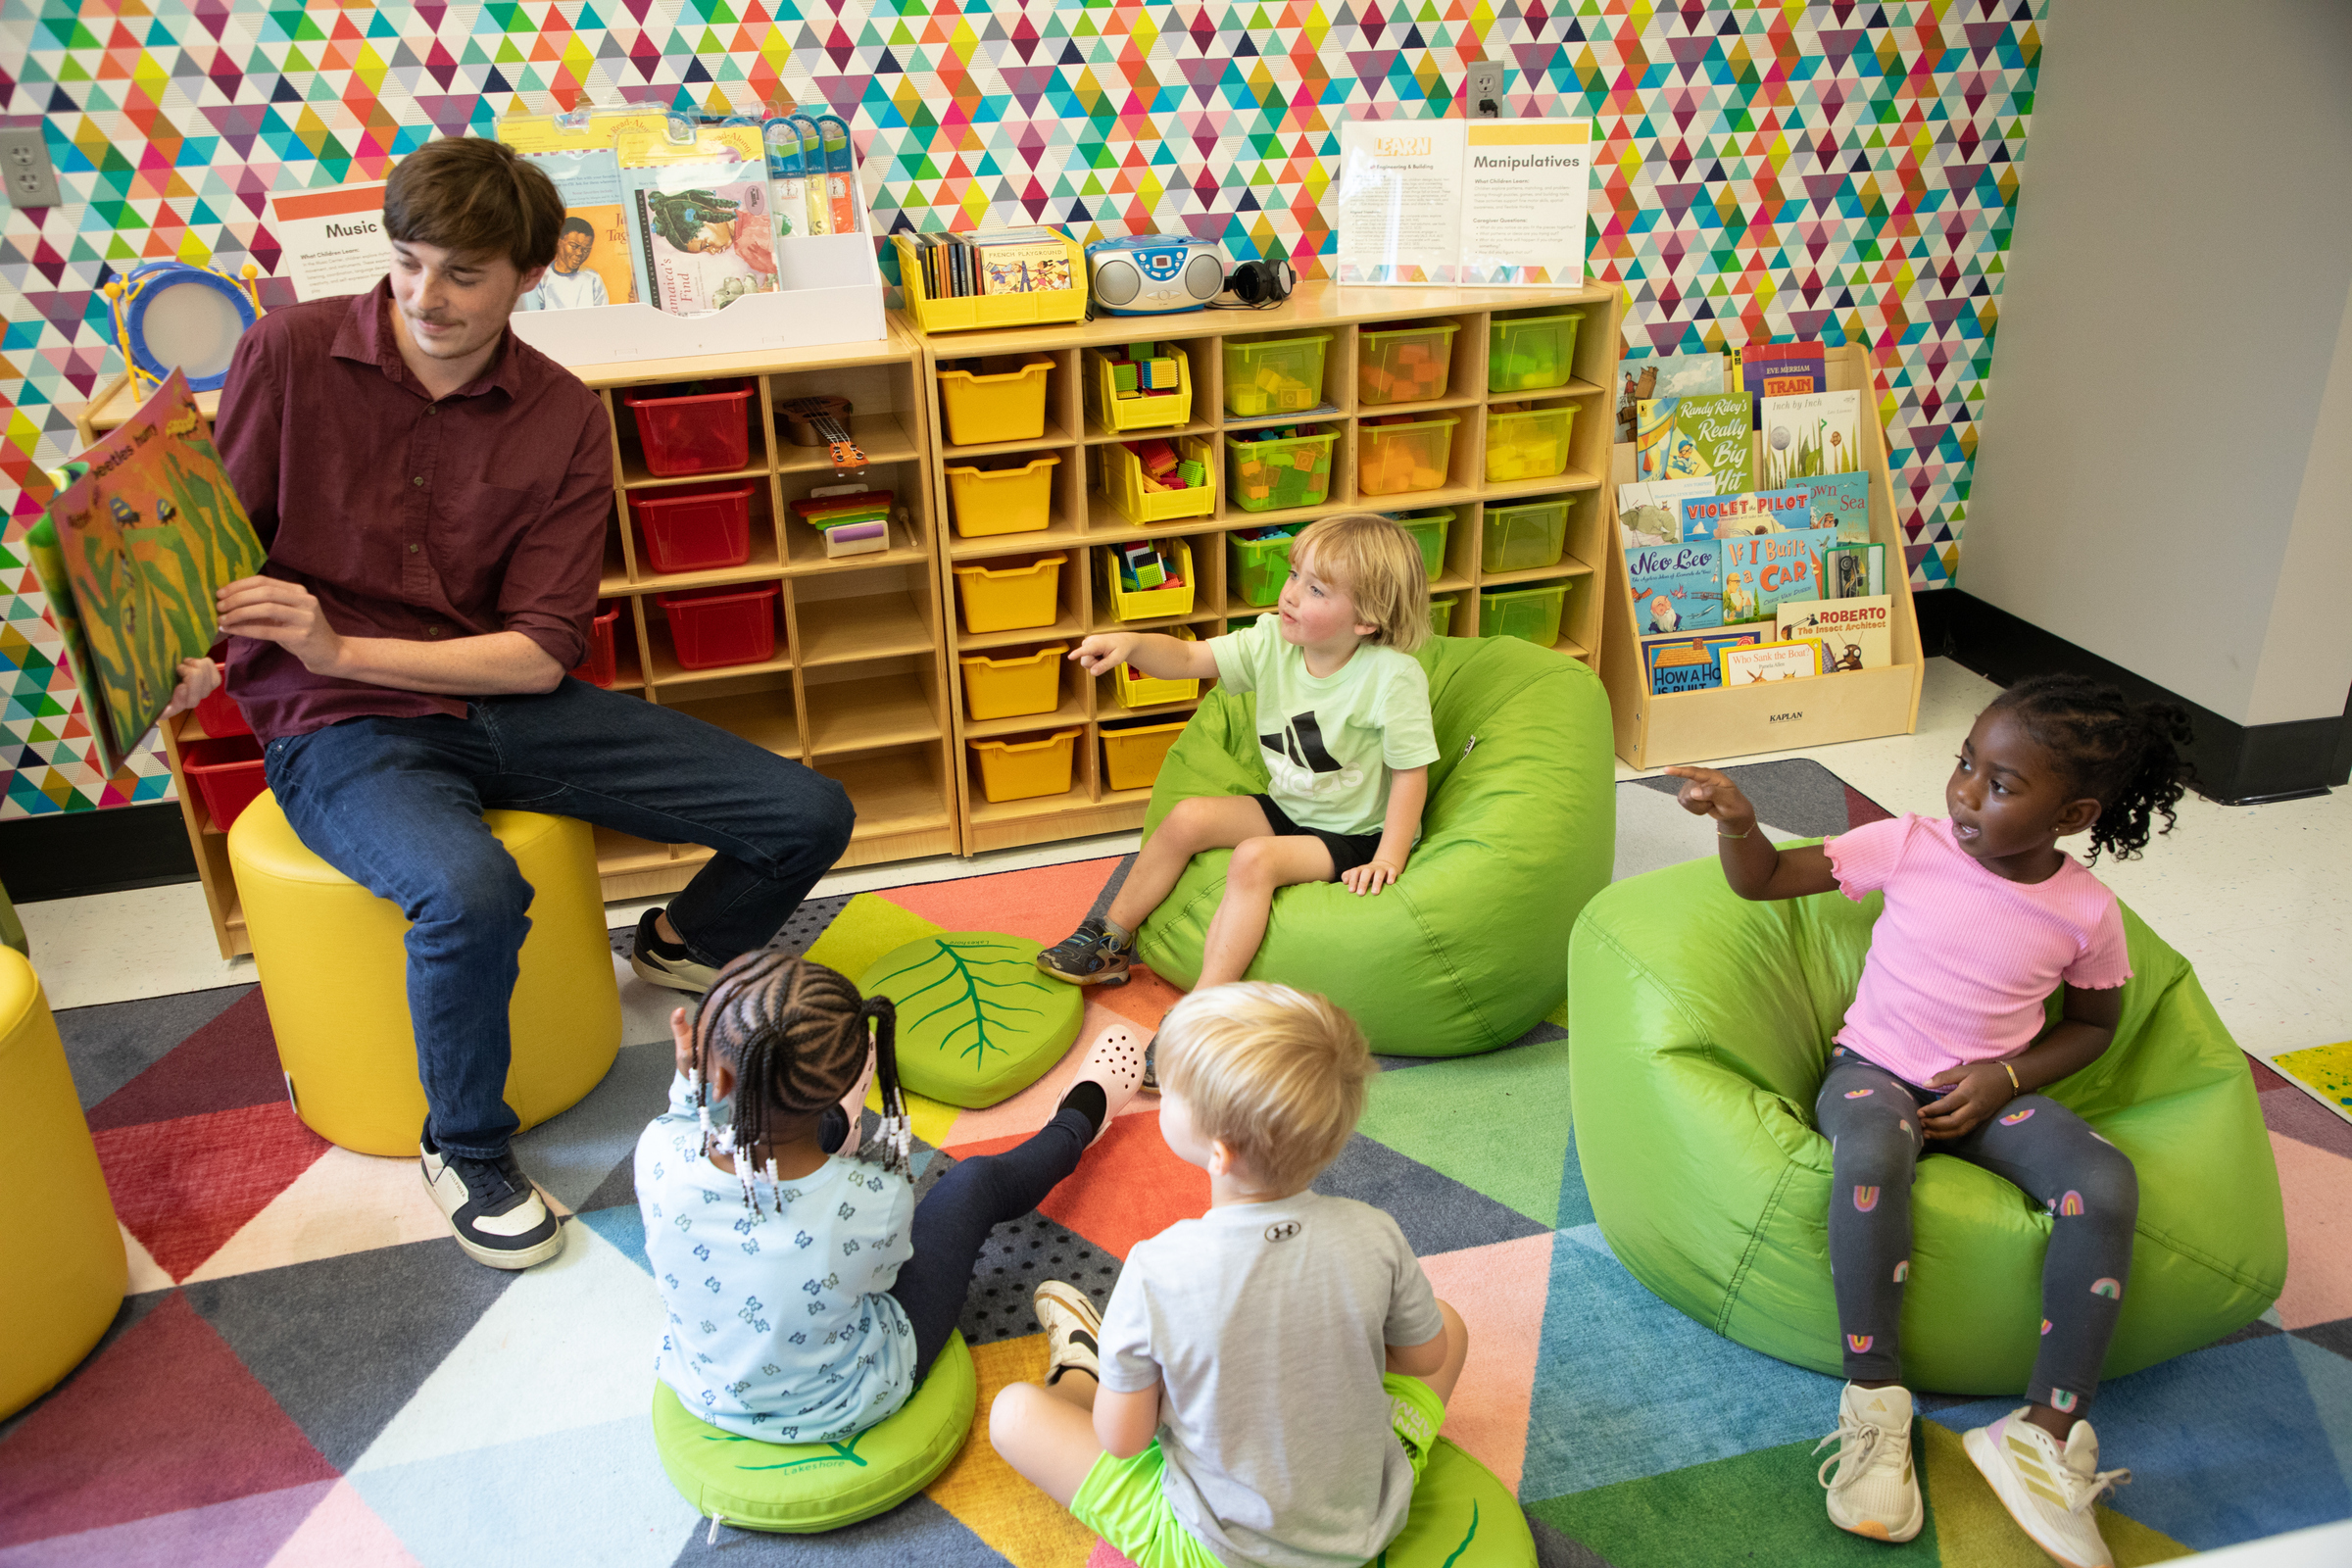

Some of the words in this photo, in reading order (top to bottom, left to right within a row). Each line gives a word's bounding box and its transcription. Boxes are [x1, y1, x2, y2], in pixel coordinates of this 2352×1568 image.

[611, 119, 651, 135] Read-Alon
[1374, 136, 1432, 157] LEARN
[1473, 154, 1580, 172] Manipulatives
[325, 220, 377, 238] Music
[644, 230, 657, 281] ANNIVERSARY
[661, 258, 679, 315] amaica's
[677, 272, 693, 303] Find
[1780, 365, 1810, 373] MERRIAM
[1767, 378, 1812, 394] TRAIN
[1680, 401, 1713, 418] Randy
[1713, 398, 1748, 416] Riley's
[1772, 401, 1789, 411] Inch
[1791, 400, 1802, 411] by
[1804, 398, 1822, 408] Inch
[1697, 417, 1748, 443] Really
[1712, 439, 1748, 468] Big
[1715, 469, 1747, 495] Hit
[1687, 500, 1748, 520] VIOLET
[1757, 494, 1808, 514] PILOT
[1839, 494, 1866, 512] Sea
[1630, 551, 1672, 575] Neo
[1672, 549, 1713, 569] Leo
[1728, 543, 1743, 567] If
[1749, 540, 1760, 564] I
[1764, 538, 1806, 563] Built
[1742, 569, 1754, 584] a
[1759, 561, 1807, 593] CAR
[1820, 608, 1886, 624] ROBERTO
[1816, 624, 1842, 634] Insect
[1845, 621, 1886, 631] Architect
[1732, 655, 1752, 664] Who
[1753, 652, 1773, 662] Sank
[1774, 651, 1787, 661] the
[1788, 647, 1810, 659] Boat?
[1653, 668, 1689, 687] HOW
[1690, 668, 1699, 683] A
[1769, 710, 1803, 722] KAPLAN
[1264, 755, 1363, 798] didas
[784, 1460, 846, 1476] Lakeshore
